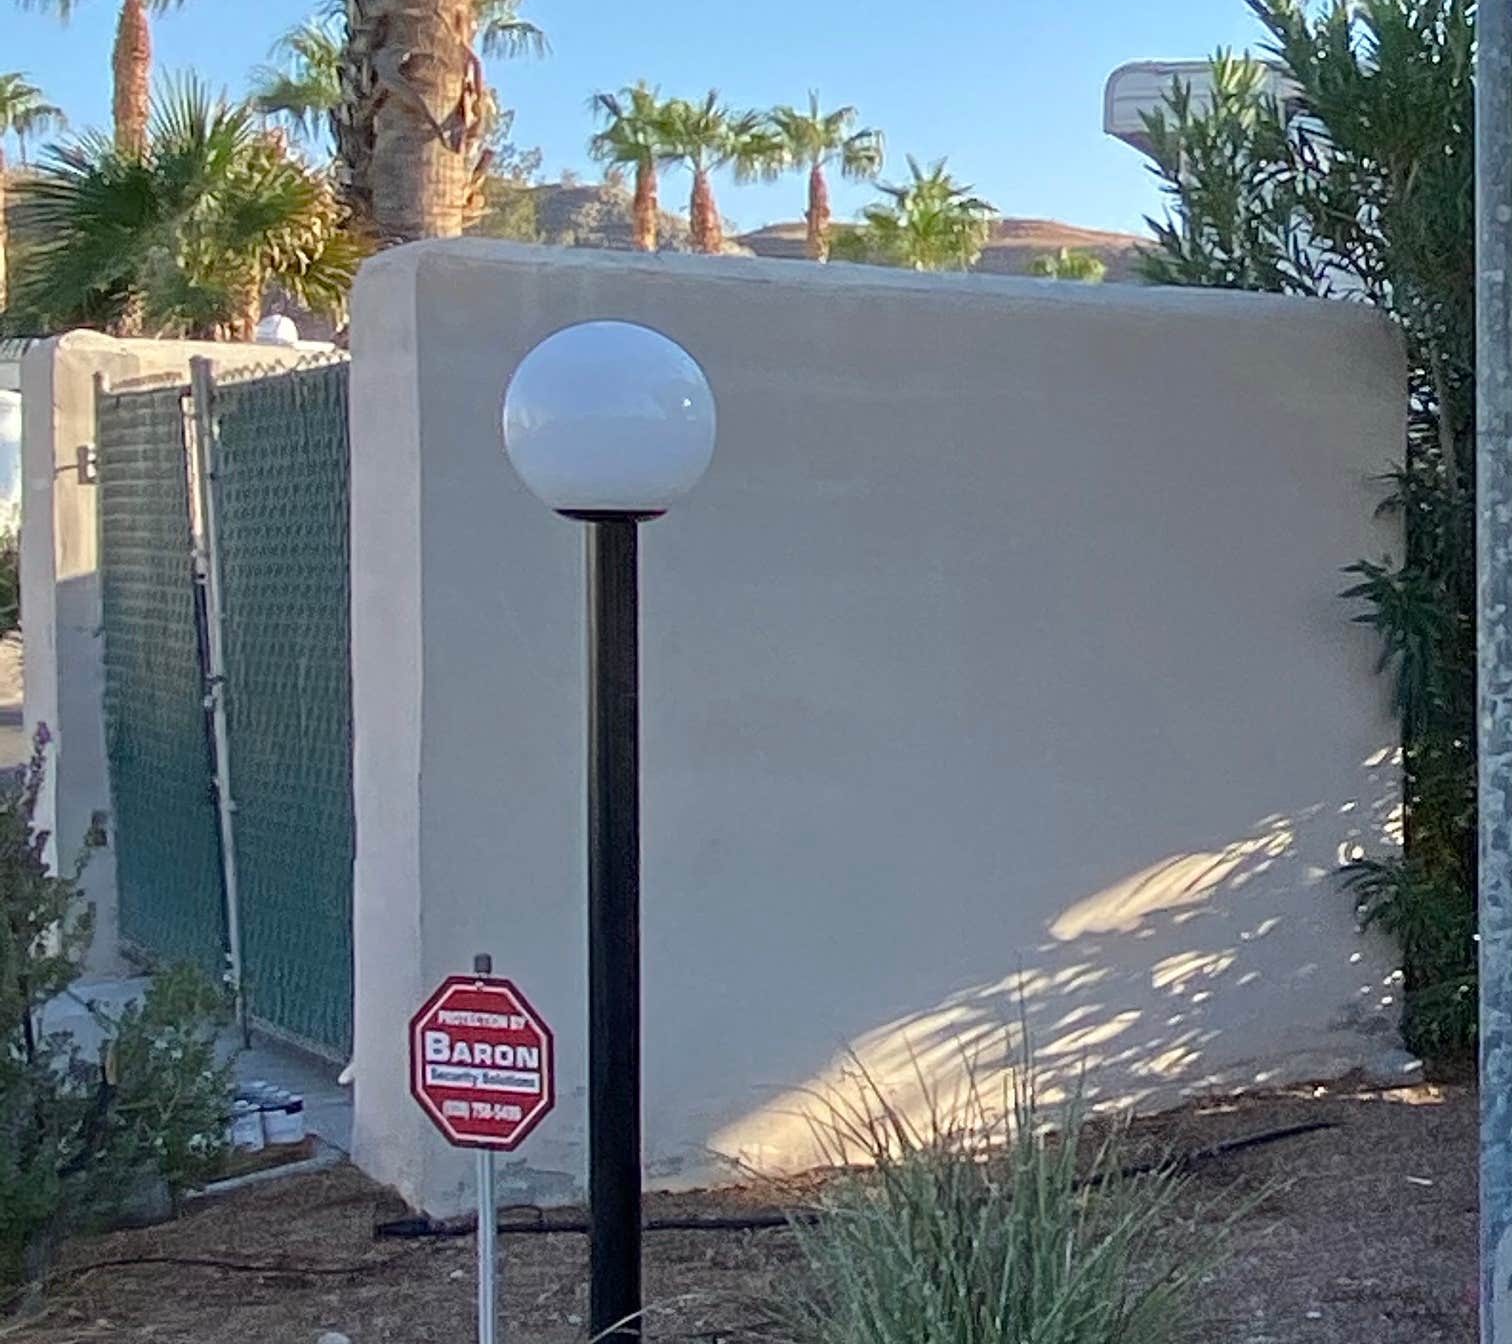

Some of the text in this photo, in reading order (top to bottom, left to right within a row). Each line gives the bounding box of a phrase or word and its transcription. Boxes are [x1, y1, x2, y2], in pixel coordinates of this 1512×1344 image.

[424, 1031, 540, 1068] BARON
[430, 1067, 536, 1088] Security Solutions
